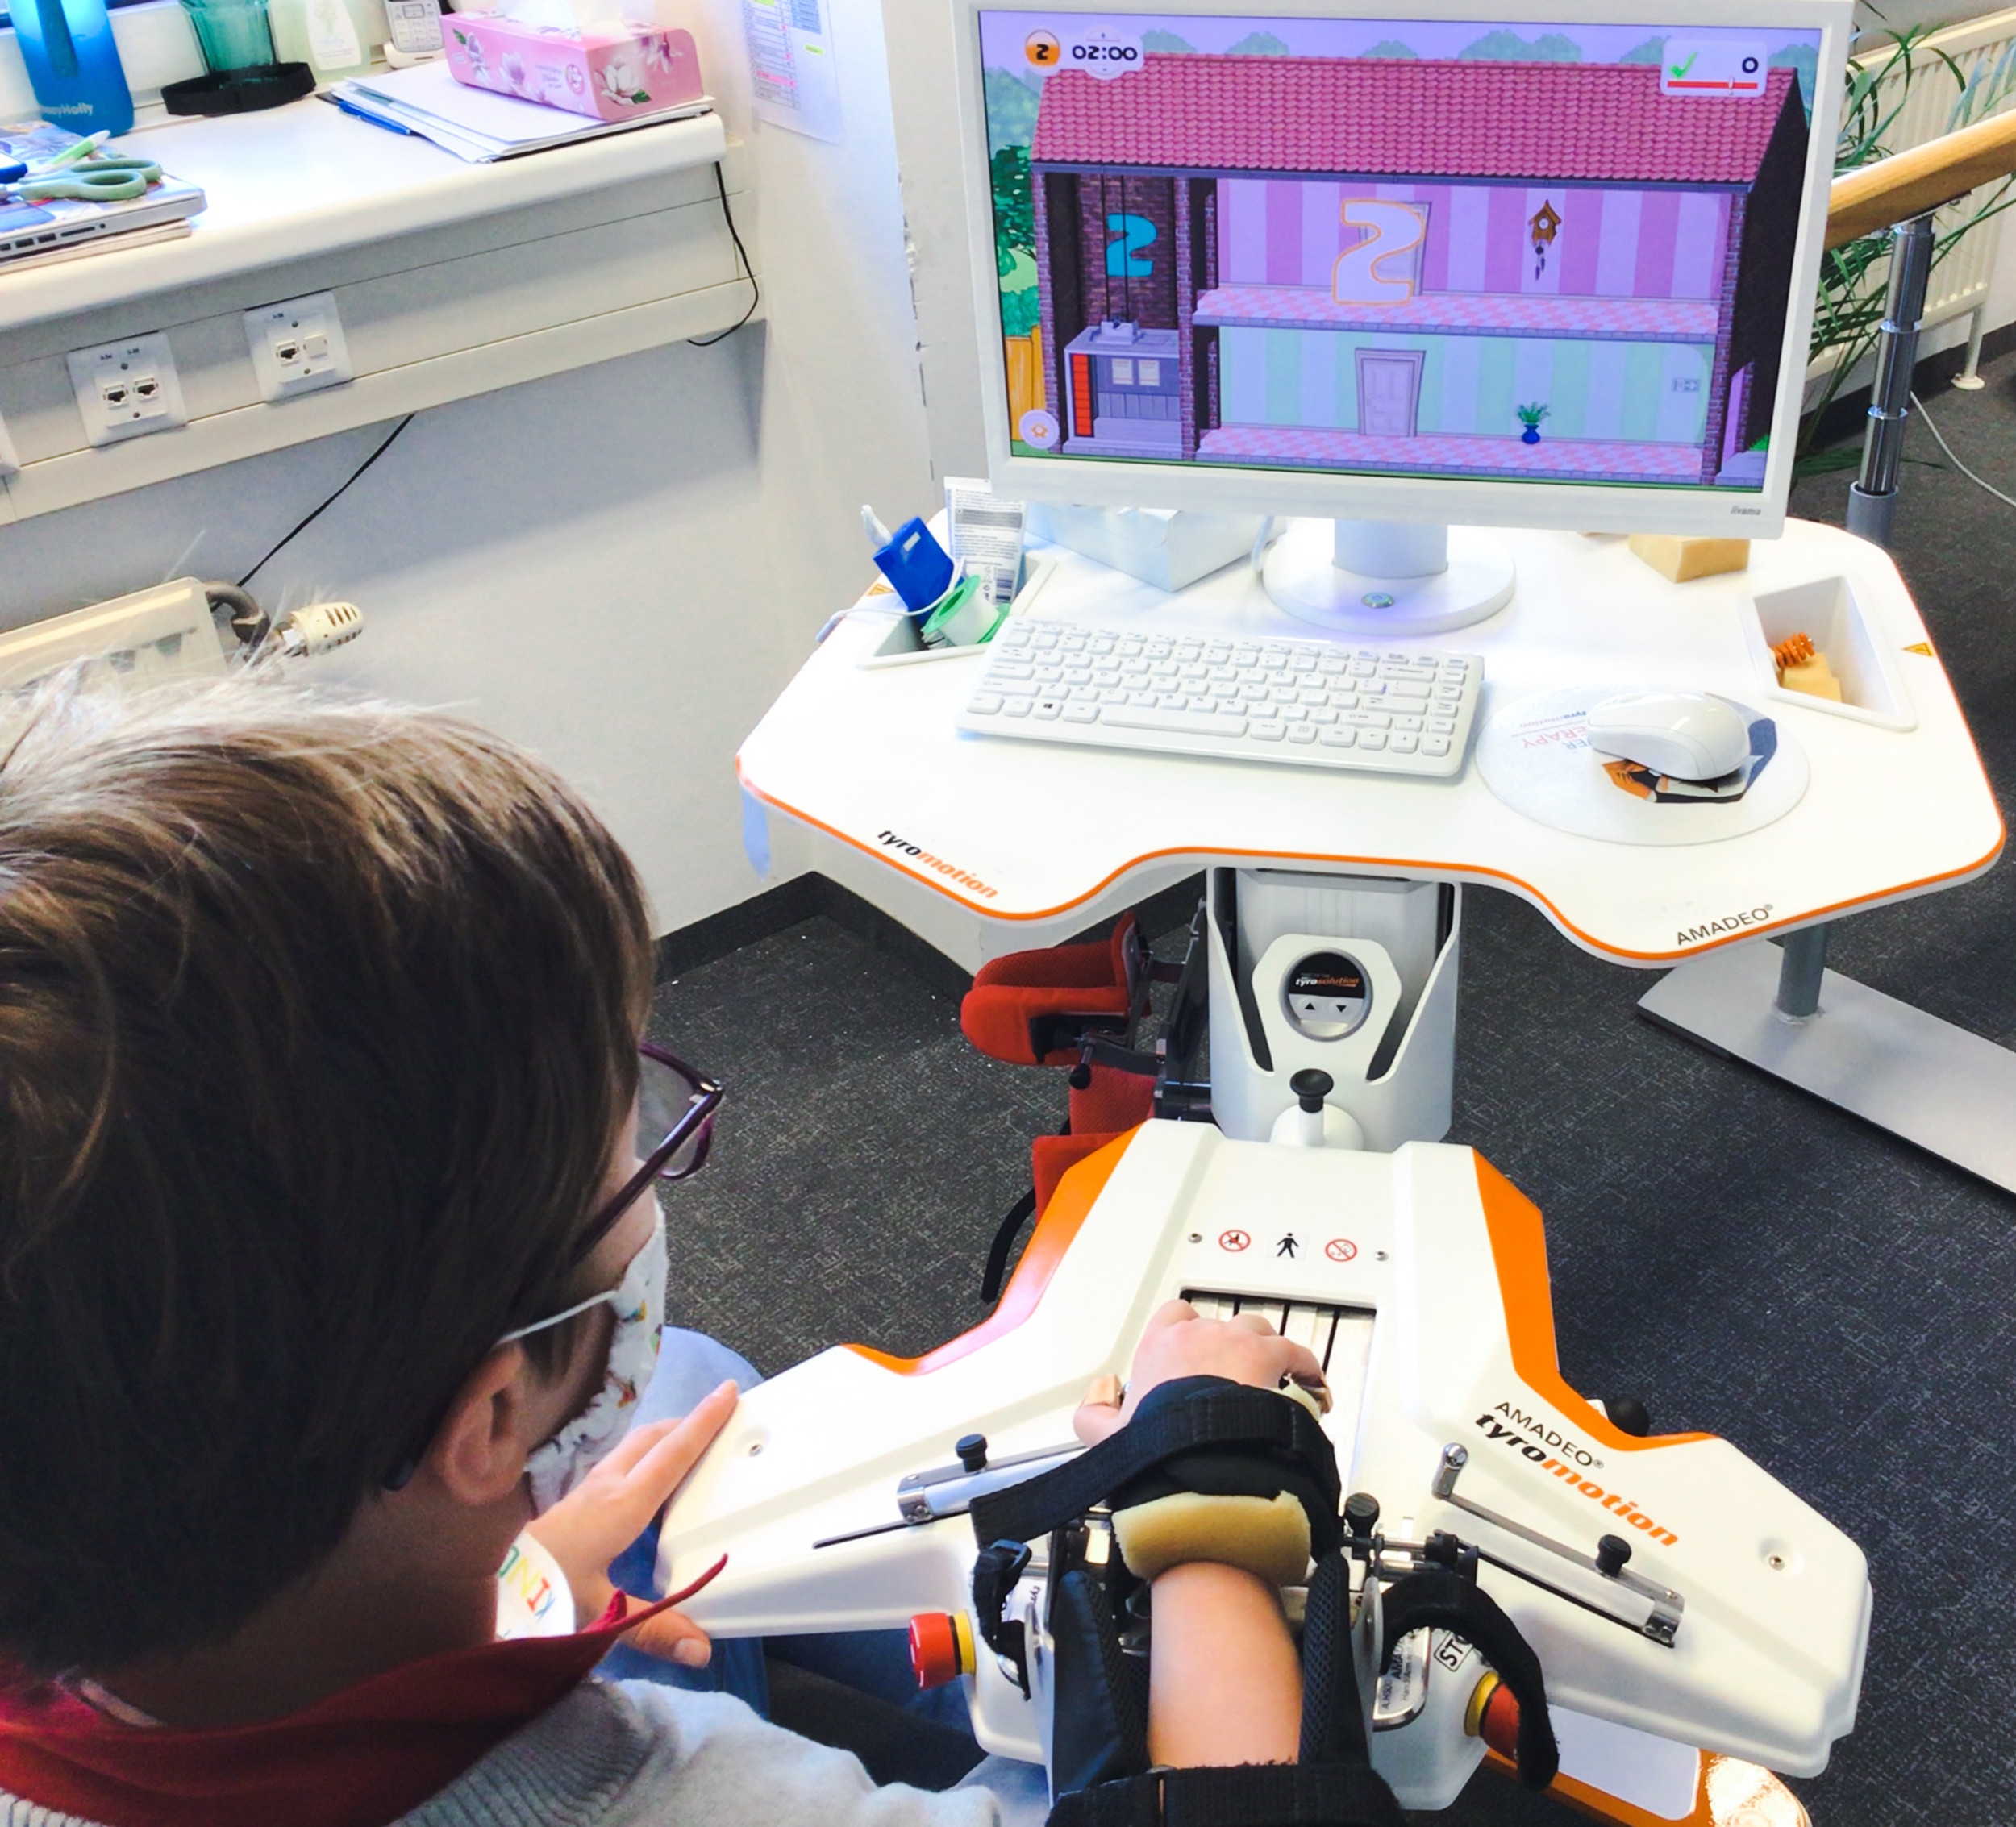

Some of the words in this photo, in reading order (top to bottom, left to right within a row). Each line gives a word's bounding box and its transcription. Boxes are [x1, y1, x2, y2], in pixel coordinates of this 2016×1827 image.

[1036, 44, 1049, 60] 2
[1072, 44, 1138, 61] 02:00
[1106, 213, 1158, 277] 2
[1332, 198, 1426, 306] 2
[1522, 726, 1587, 748] ERAPY
[877, 830, 998, 898] tyromotion
[1295, 977, 1360, 988] tyrosolution
[1475, 1414, 1678, 1546] tyromotion
[1439, 1636, 1468, 1667] ST
